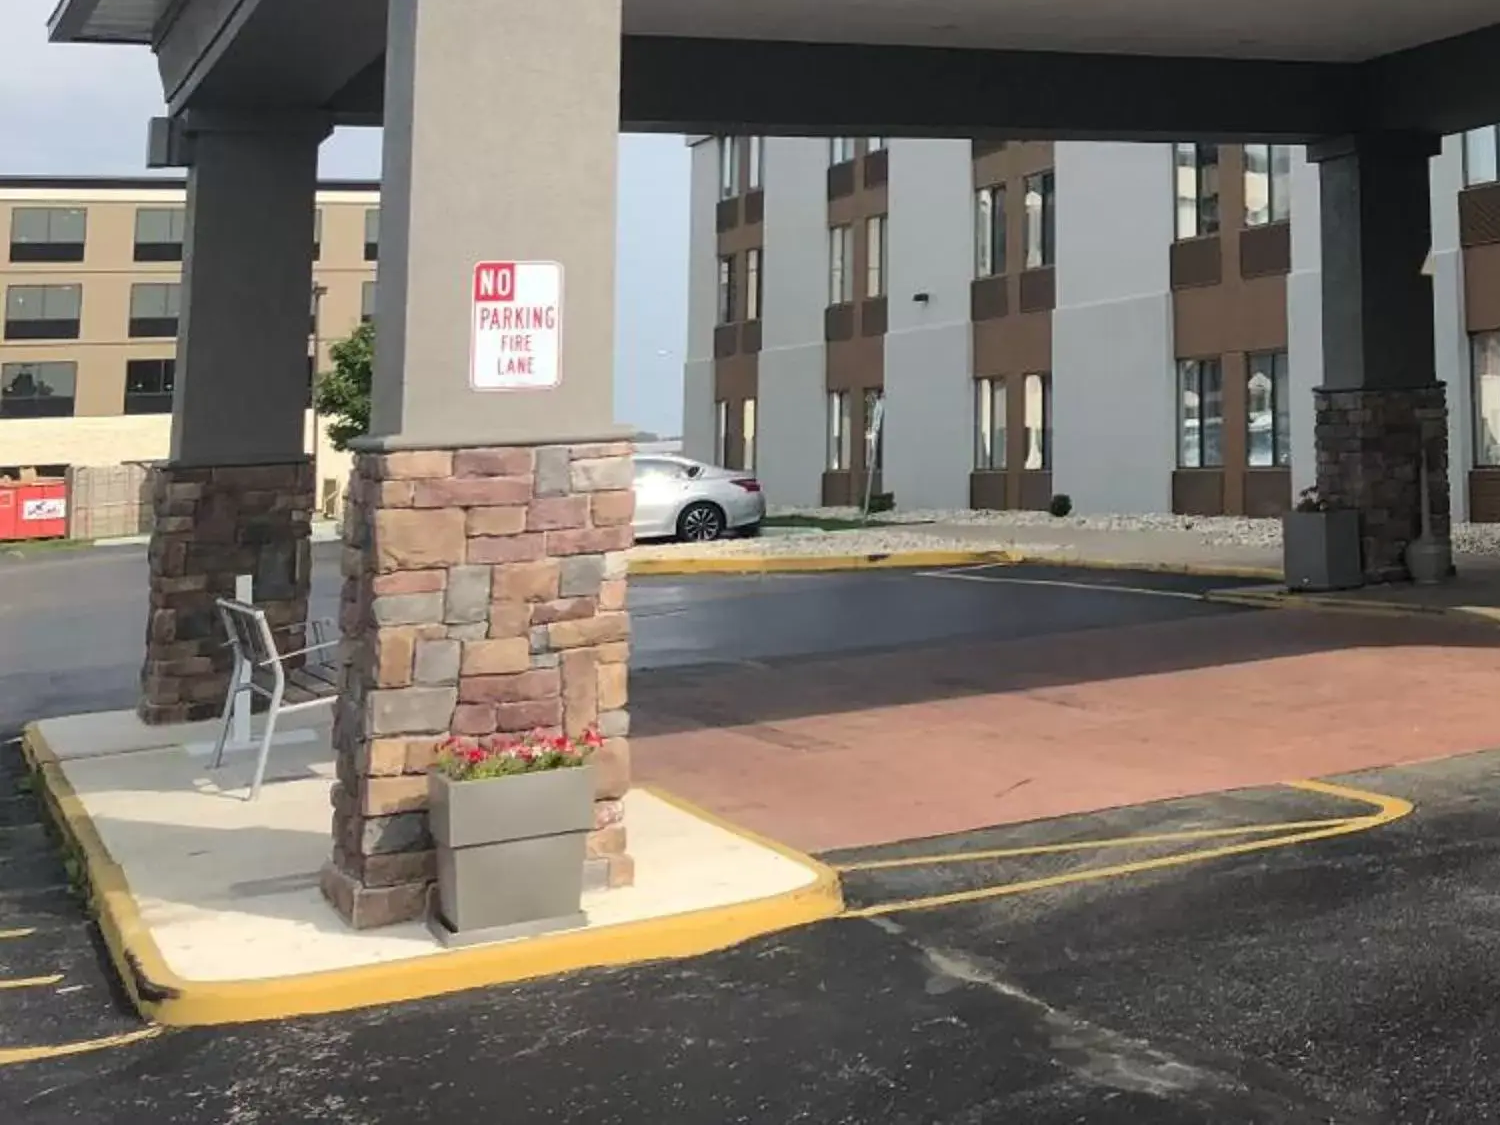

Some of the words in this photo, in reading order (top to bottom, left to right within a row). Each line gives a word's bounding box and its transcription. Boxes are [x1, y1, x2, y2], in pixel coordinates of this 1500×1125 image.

[480, 268, 511, 296] NO
[480, 306, 555, 330] PARKING
[501, 334, 533, 353] FIRE
[497, 356, 536, 375] LANE
